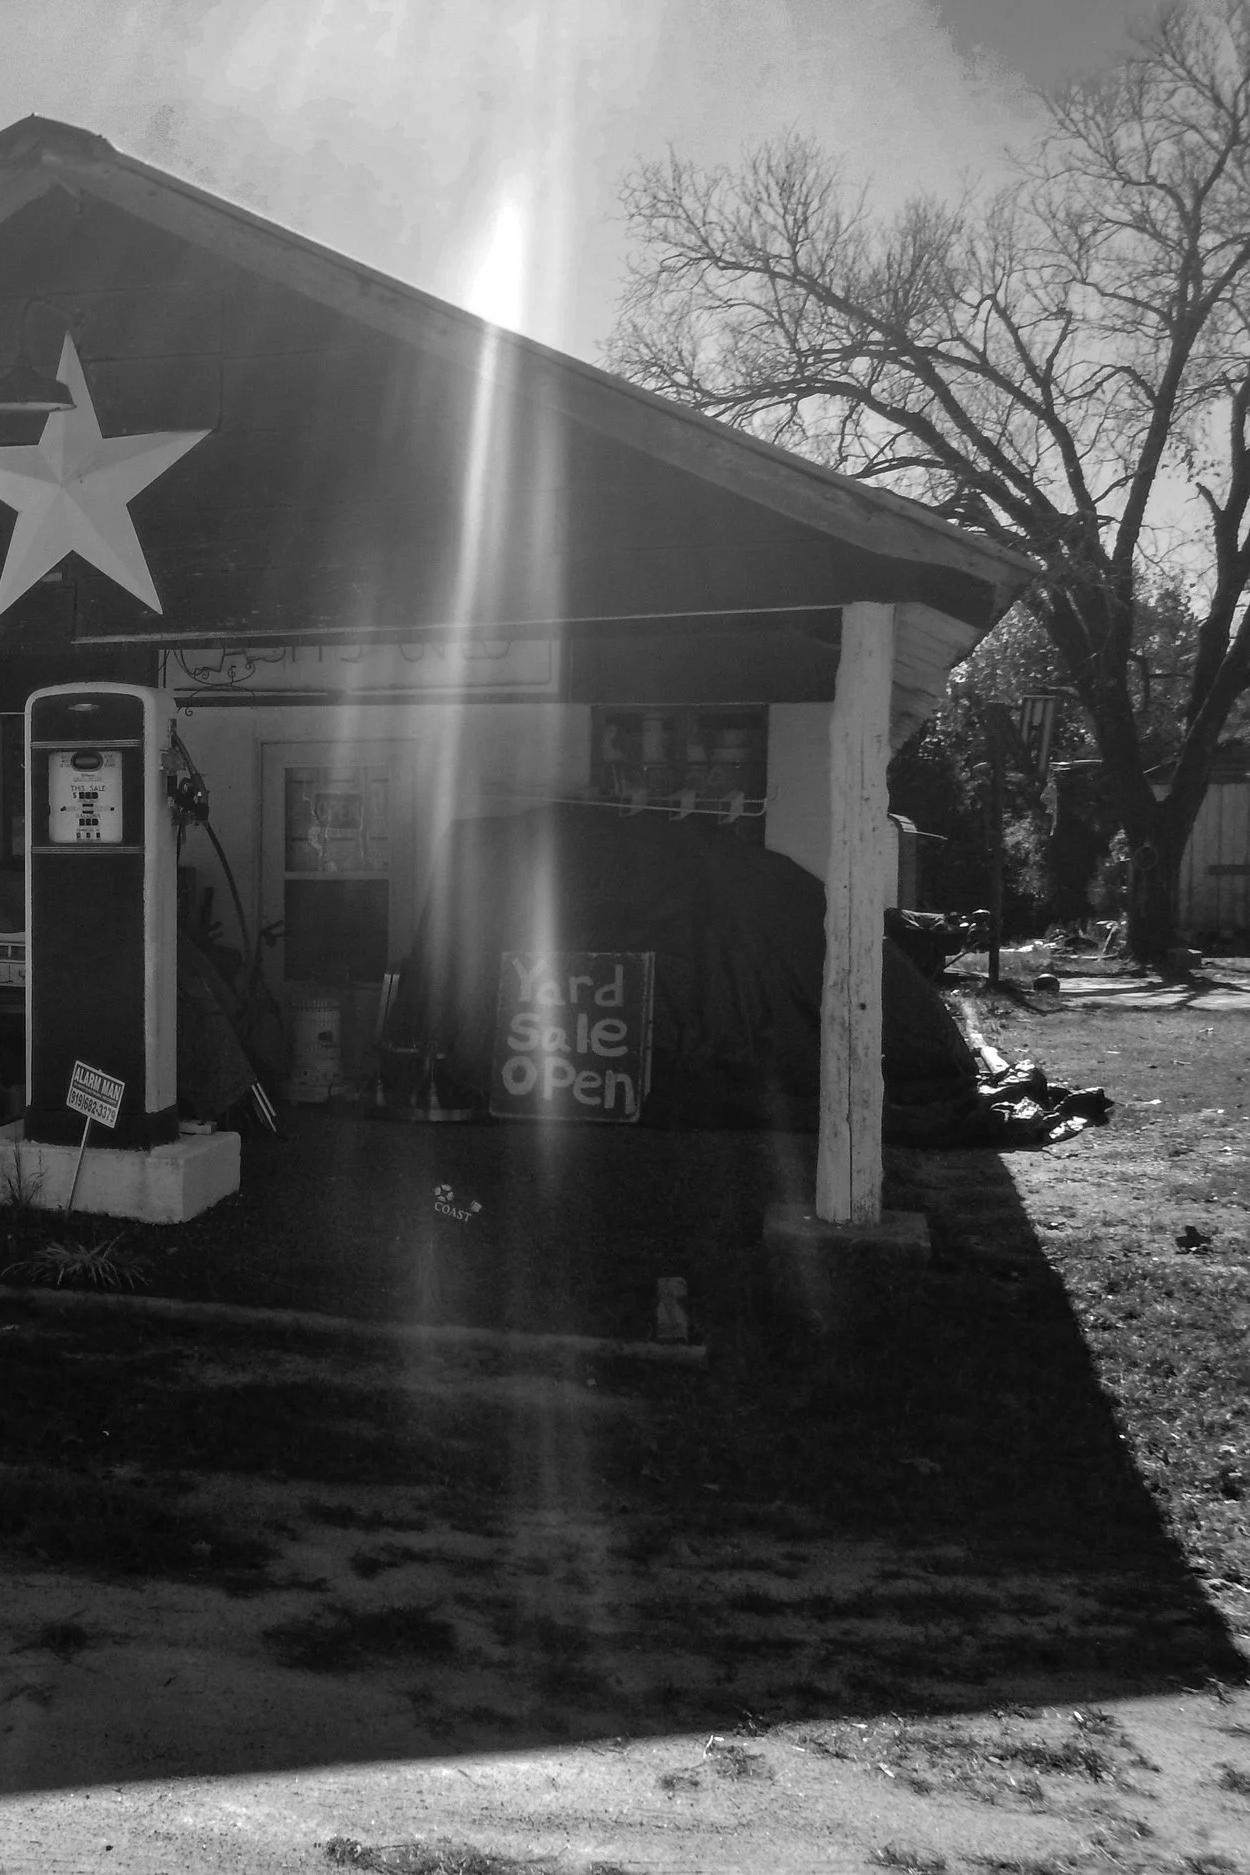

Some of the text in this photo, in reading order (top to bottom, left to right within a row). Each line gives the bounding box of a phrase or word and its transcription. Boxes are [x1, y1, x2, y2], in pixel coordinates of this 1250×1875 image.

[510, 957, 625, 1008] Yard
[507, 1012, 628, 1057] Sale
[74, 1066, 103, 1092] ALARM
[101, 1079, 122, 1101] MAN
[434, 1201, 472, 1222] COAST
